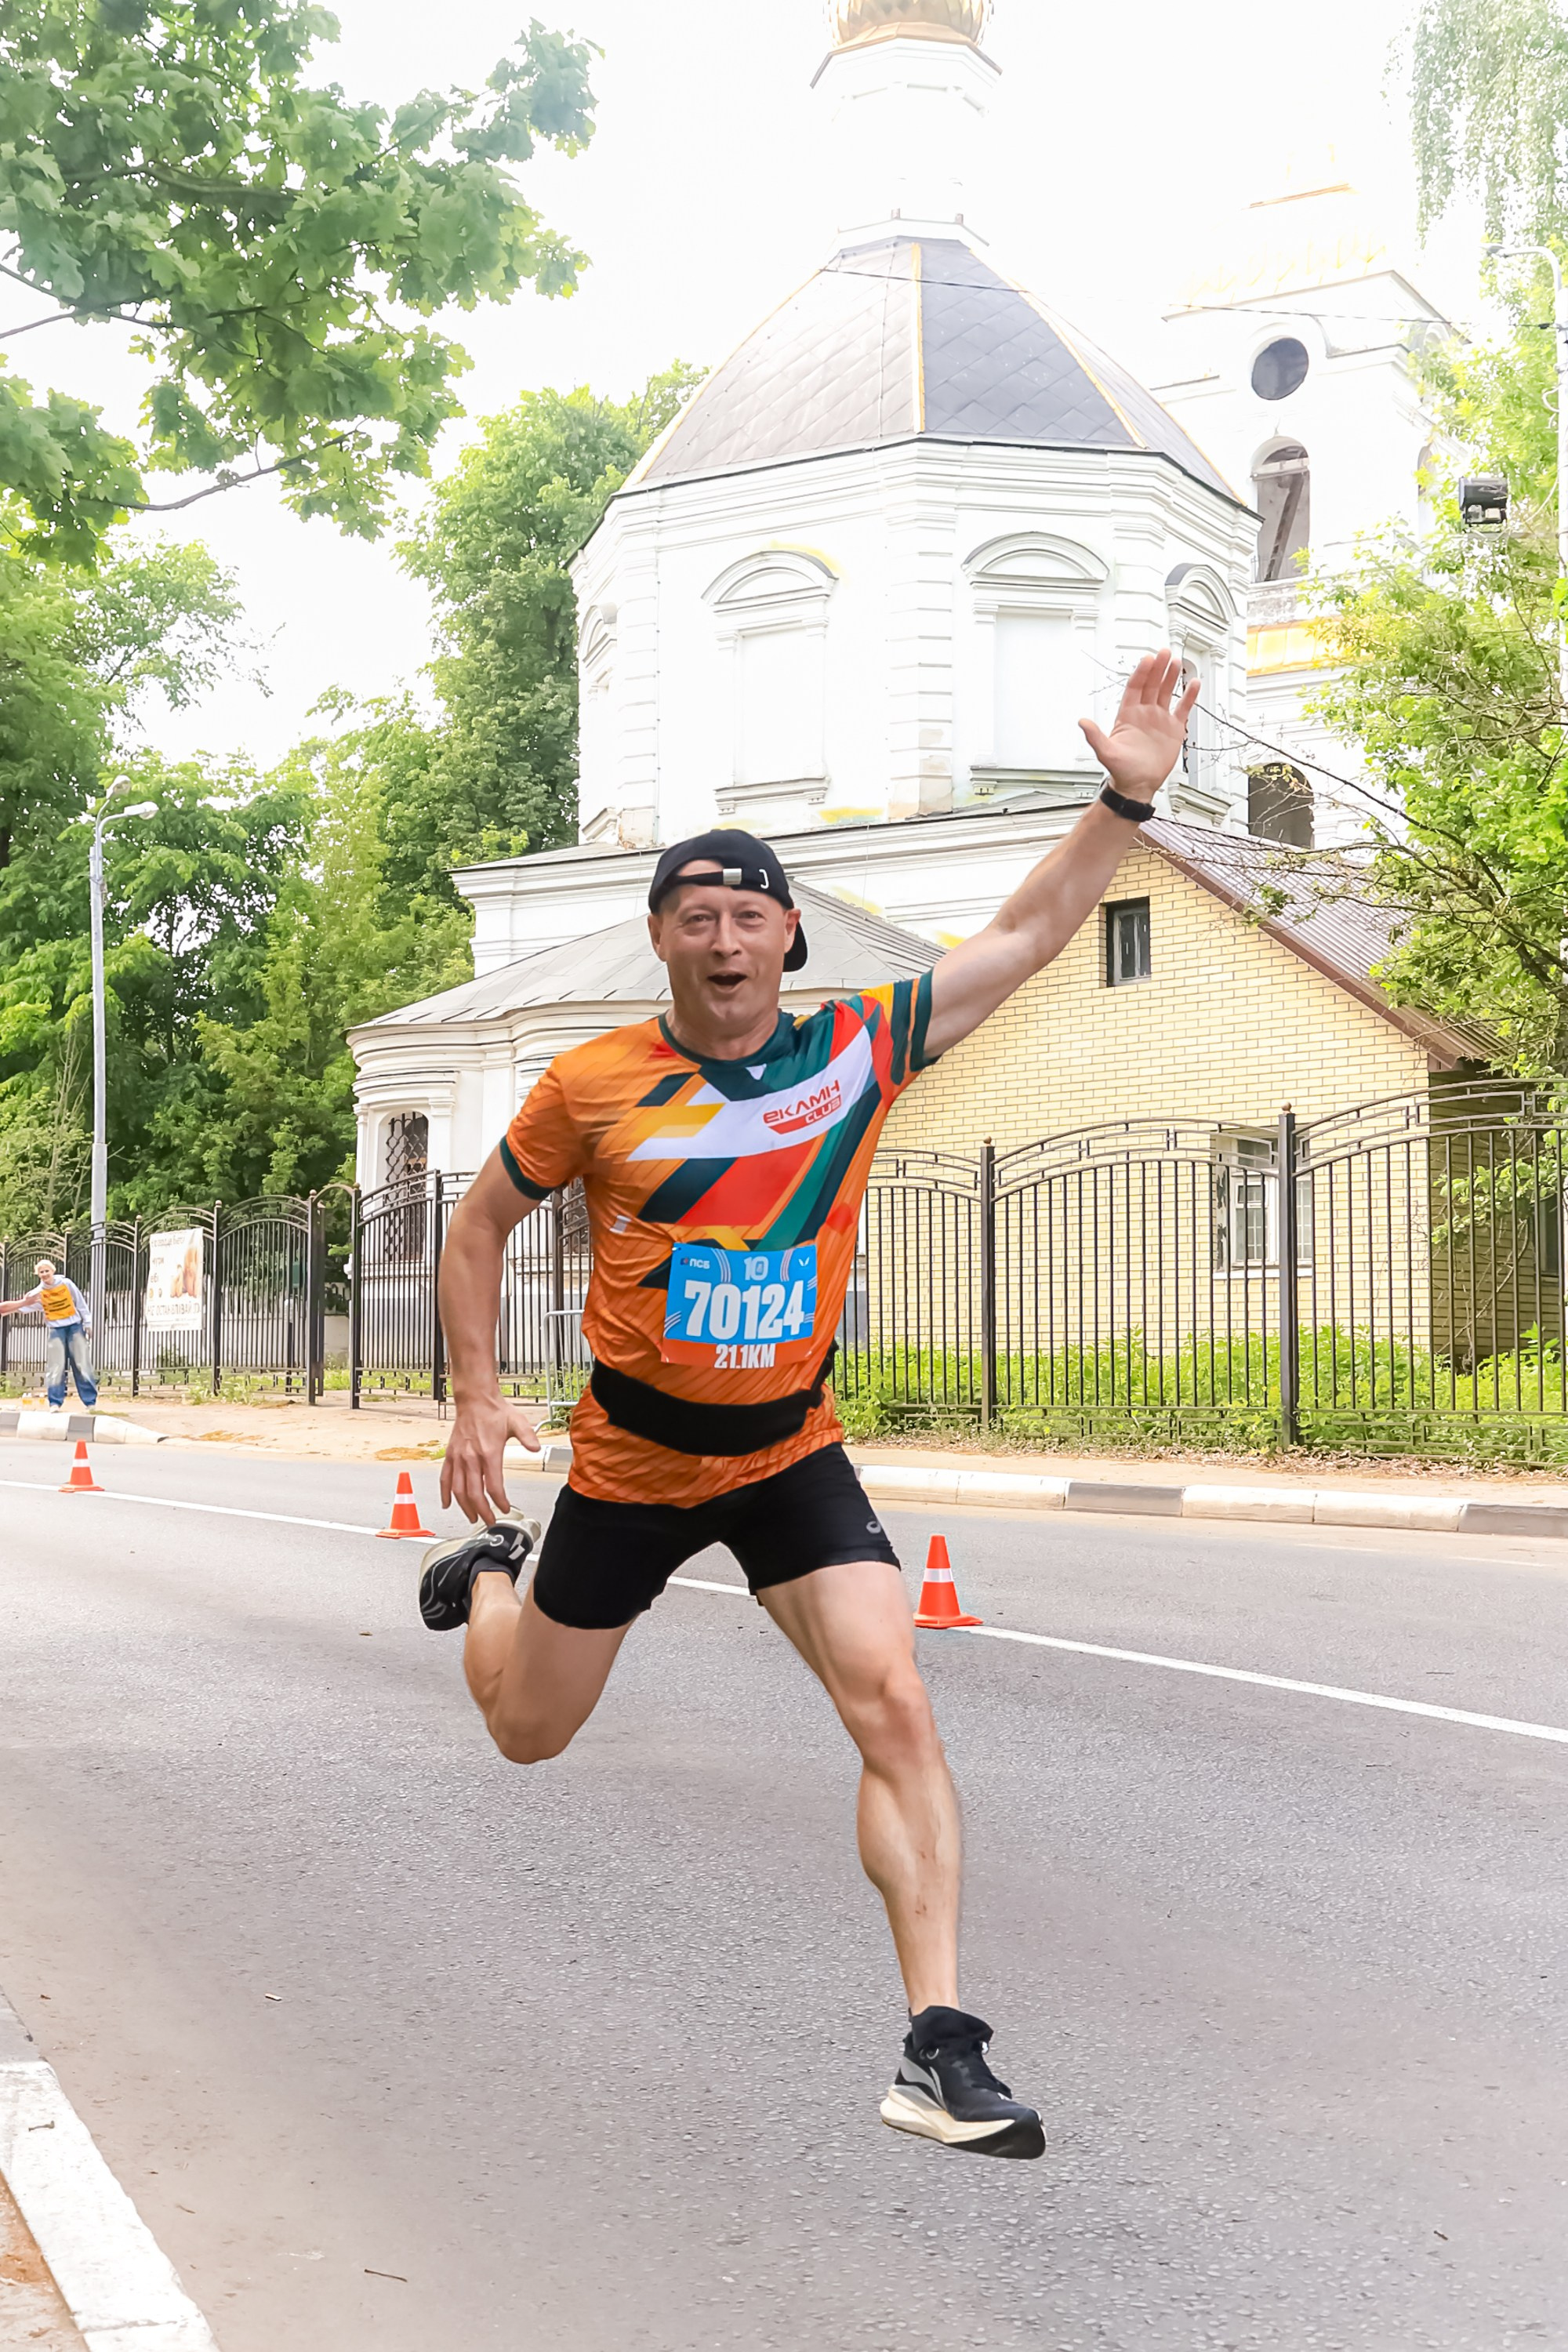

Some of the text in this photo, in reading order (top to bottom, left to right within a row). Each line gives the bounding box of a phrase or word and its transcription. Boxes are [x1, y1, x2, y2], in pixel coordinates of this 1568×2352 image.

[804, 1098, 840, 1124] CLUB
[743, 1256, 769, 1281] 10
[684, 1279, 804, 1340] 70124
[713, 1343, 776, 1369] 21.1KM
